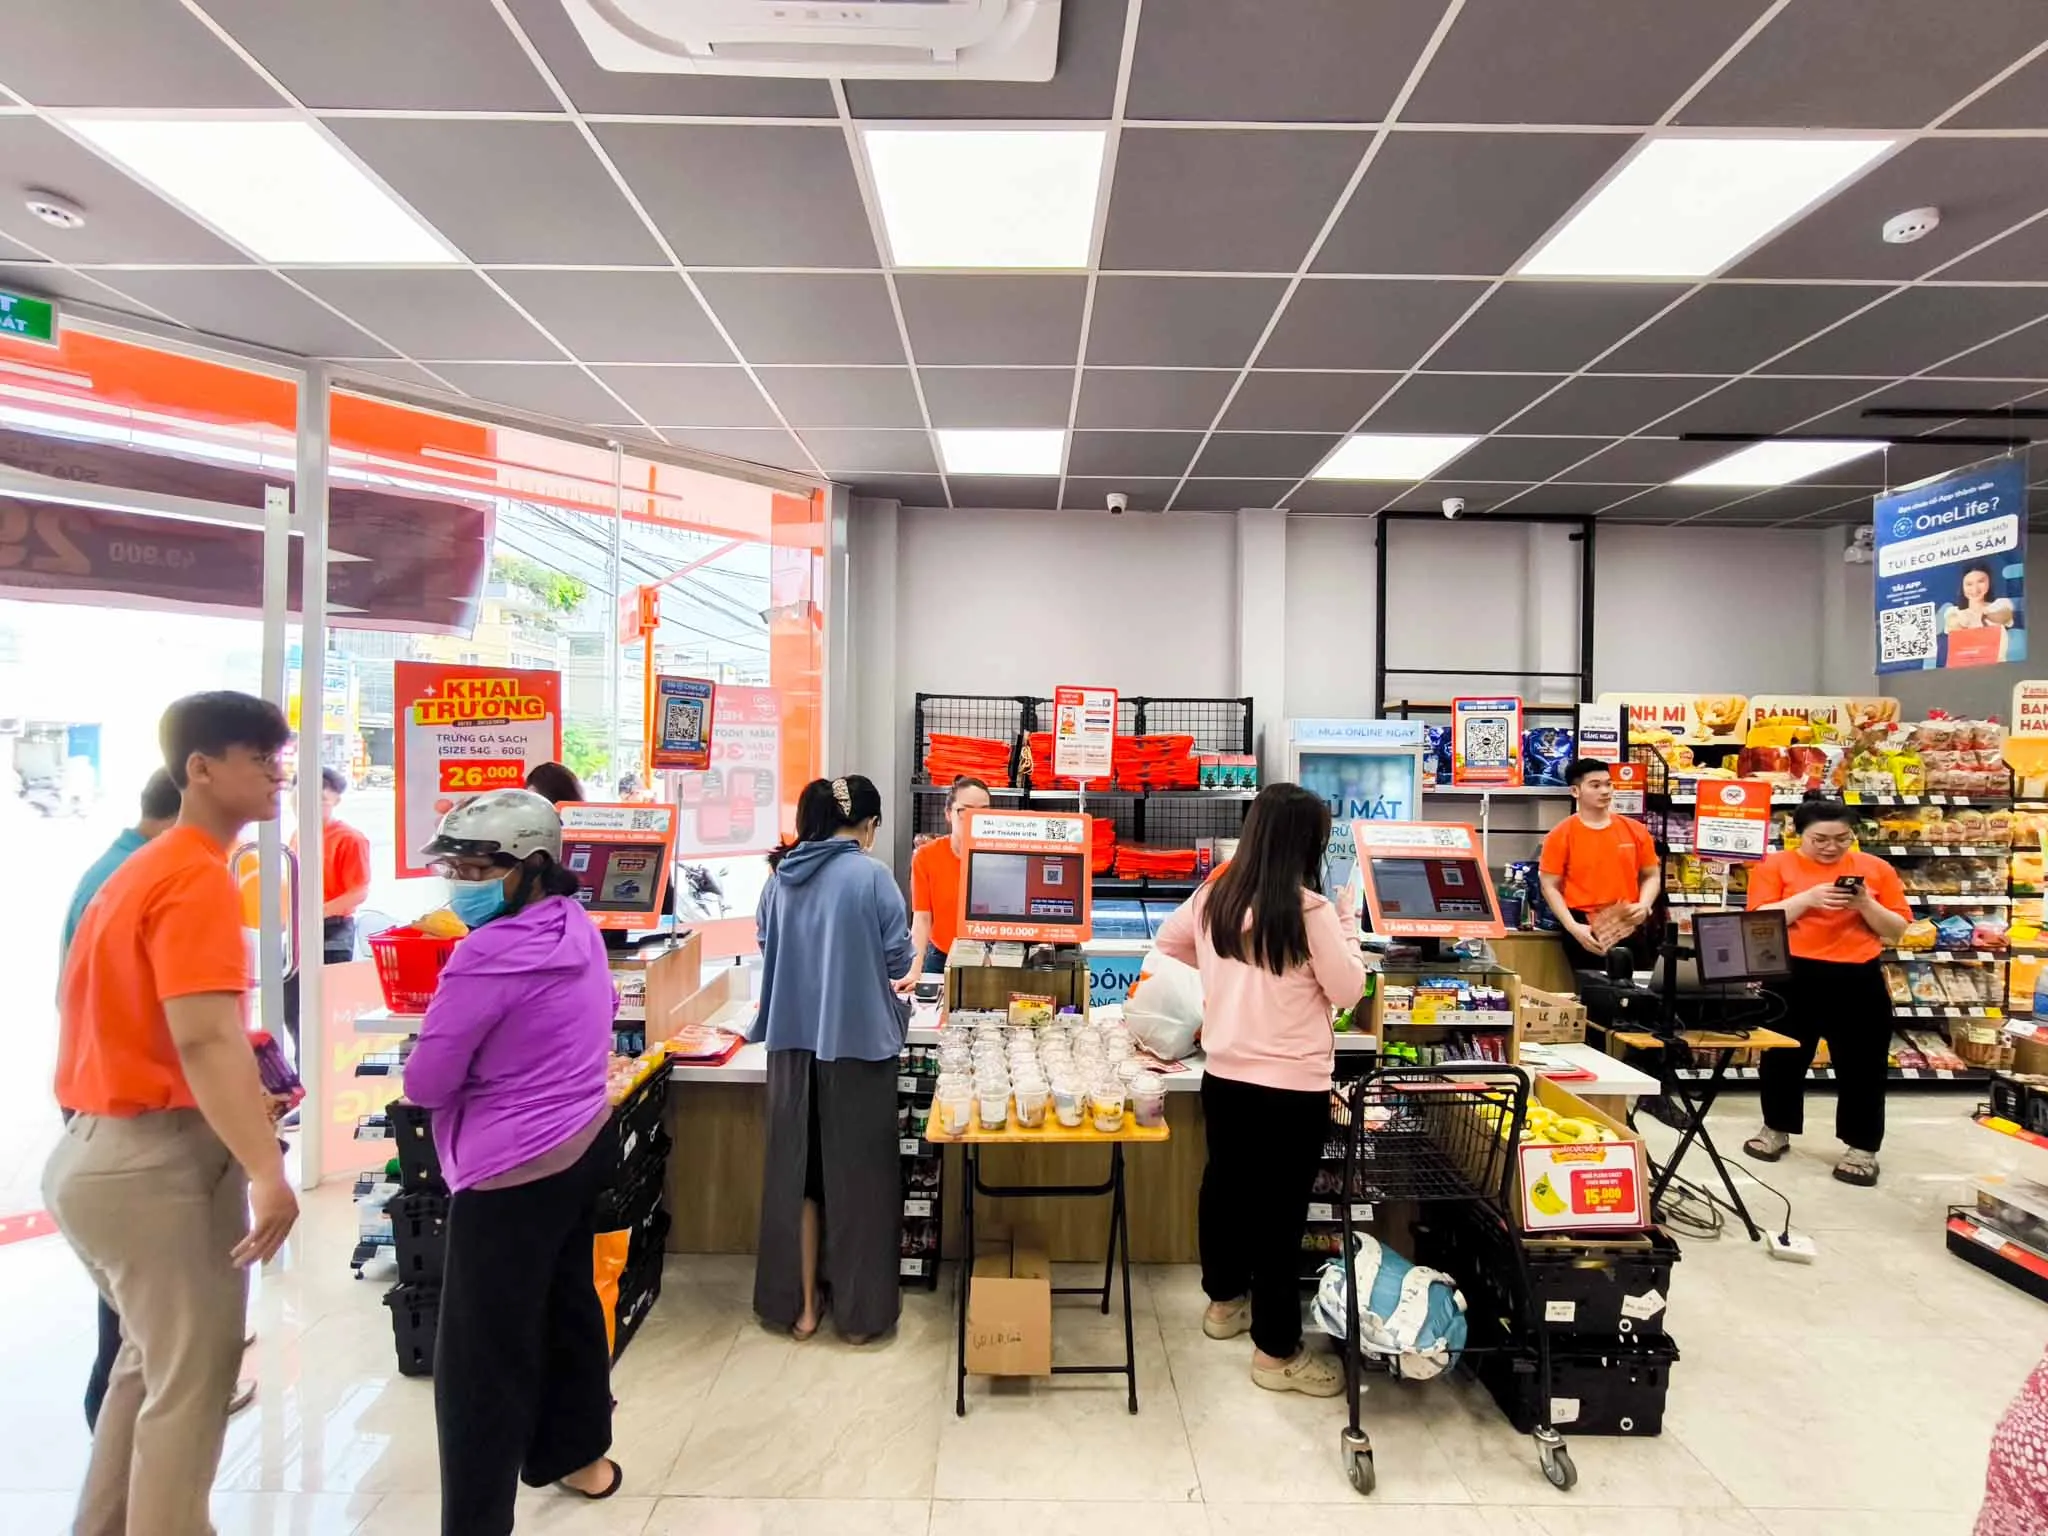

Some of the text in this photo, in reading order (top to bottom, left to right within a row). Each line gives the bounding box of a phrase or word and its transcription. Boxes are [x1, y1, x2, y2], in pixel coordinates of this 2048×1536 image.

[0, 315, 28, 331] ÁT
[1916, 496, 2000, 530] OneLife?
[1911, 552, 1936, 566] ECO
[1940, 544, 1970, 558] MUA
[447, 680, 516, 698] KHAI
[1629, 705, 1657, 721] NH
[1345, 728, 1383, 737] ONLINE
[1386, 728, 1415, 738] NGAY
[438, 746, 467, 756] (SIZE
[470, 746, 491, 755] 54G
[502, 747, 526, 756] 60G)
[448, 766, 518, 787] 26.000
[1327, 794, 1402, 819] Ủ MÁT
